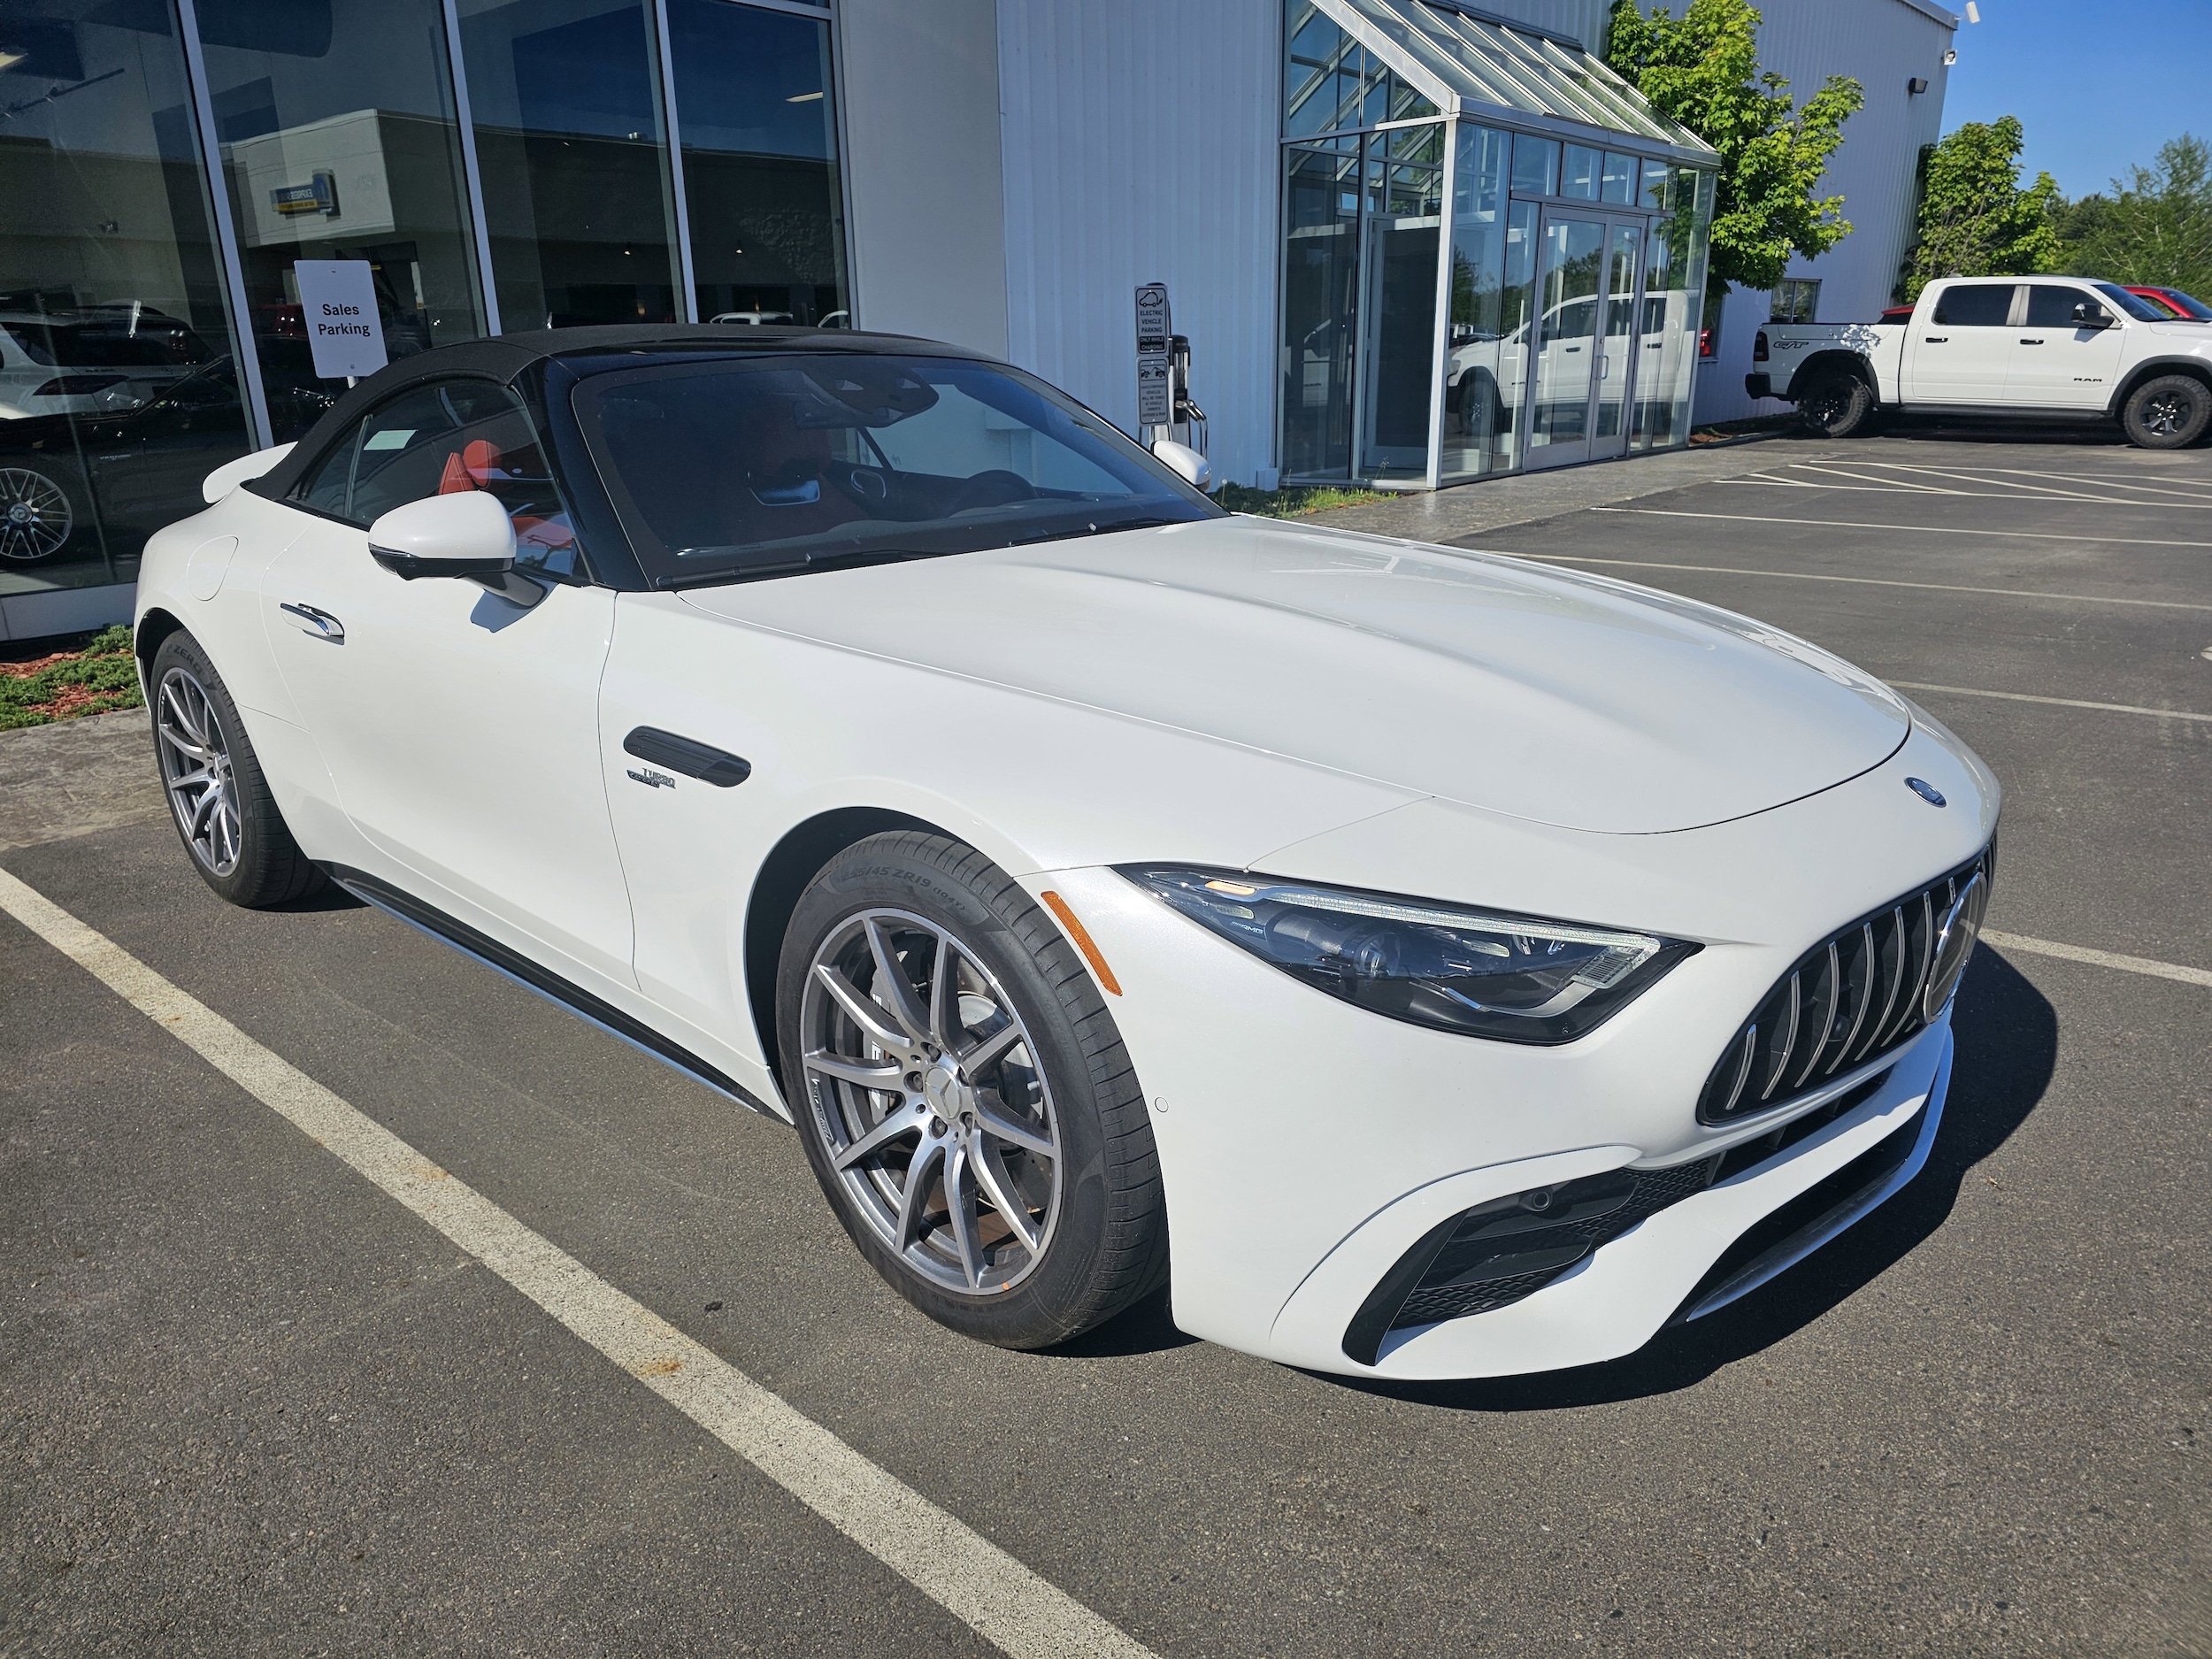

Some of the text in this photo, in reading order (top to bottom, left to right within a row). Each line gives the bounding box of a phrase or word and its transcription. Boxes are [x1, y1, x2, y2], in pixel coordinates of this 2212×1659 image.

[322, 303, 360, 316] Sales
[318, 323, 371, 337] Parking
[173, 644, 204, 674] ZERO
[641, 767, 676, 789] TURBO
[892, 868, 932, 887] ZR19
